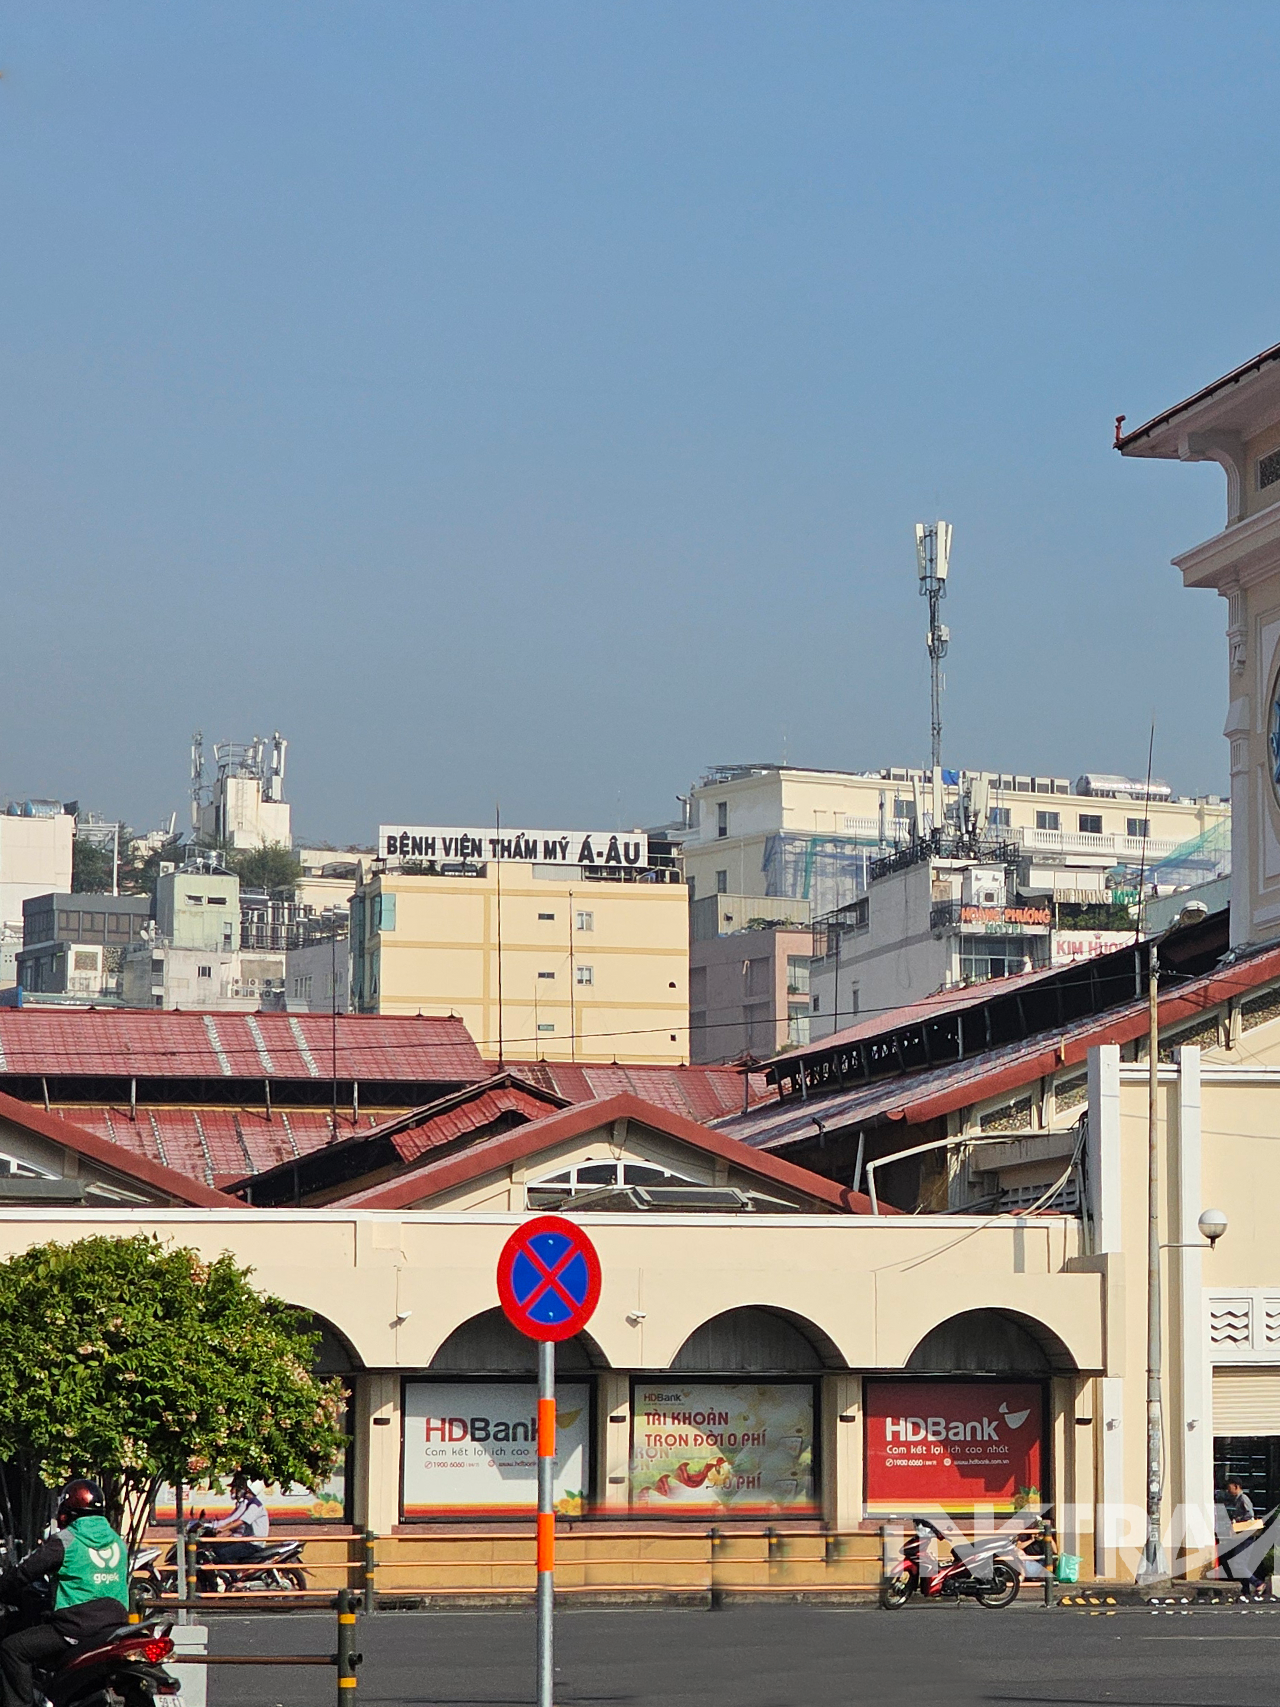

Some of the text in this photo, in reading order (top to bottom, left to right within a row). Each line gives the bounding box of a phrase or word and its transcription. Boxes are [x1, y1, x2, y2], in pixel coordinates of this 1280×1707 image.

[386, 831, 641, 865] BỆNH VIỆN THẨM MỸ Á-ÂU
[1056, 940, 1084, 956] KIM
[643, 1393, 682, 1402] HDBank
[644, 1407, 729, 1426] TÀI KHOẢN
[885, 1417, 1000, 1442] HDBank
[645, 1433, 689, 1451] TRỌN
[693, 1430, 724, 1447] ĐỜI
[741, 1429, 767, 1447] PHÍ
[425, 1447, 447, 1457] Cam
[451, 1446, 469, 1457] kết
[491, 1446, 506, 1457] ích
[511, 1448, 530, 1457] cao
[886, 1444, 907, 1455] Cam
[910, 1444, 928, 1455] kết
[947, 1444, 961, 1454] ích
[965, 1446, 982, 1454] cao
[433, 1461, 449, 1469] 1900
[449, 1461, 465, 1469] 6060
[736, 1471, 763, 1490] PHÍ
[94, 1572, 120, 1584] gojek
